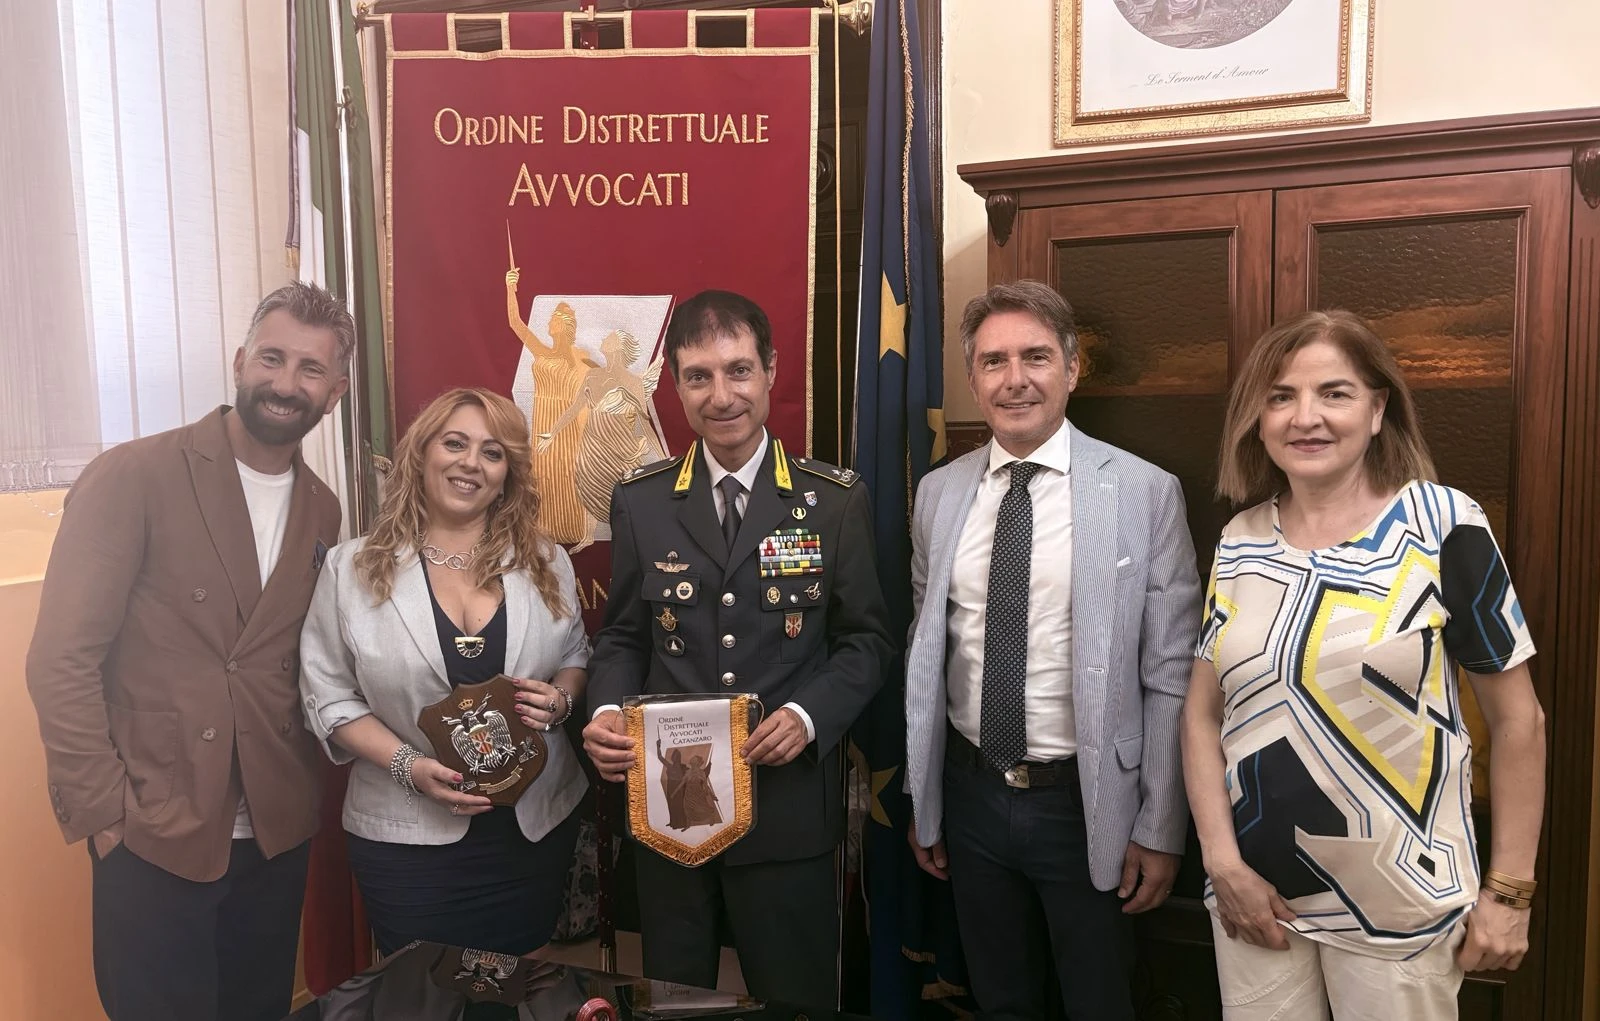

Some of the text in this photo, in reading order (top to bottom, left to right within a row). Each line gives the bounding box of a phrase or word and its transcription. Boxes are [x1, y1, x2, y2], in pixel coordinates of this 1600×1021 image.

[1144, 65, 1269, 87] Le Serment d'Amour
[434, 105, 769, 146] ORDINE DISTRETTUALE
[508, 162, 689, 207] AVVOCATI
[664, 722, 709, 731] DISTRETTUALE
[669, 729, 703, 737] AVVOCATI
[673, 736, 712, 745] CATANZARO
